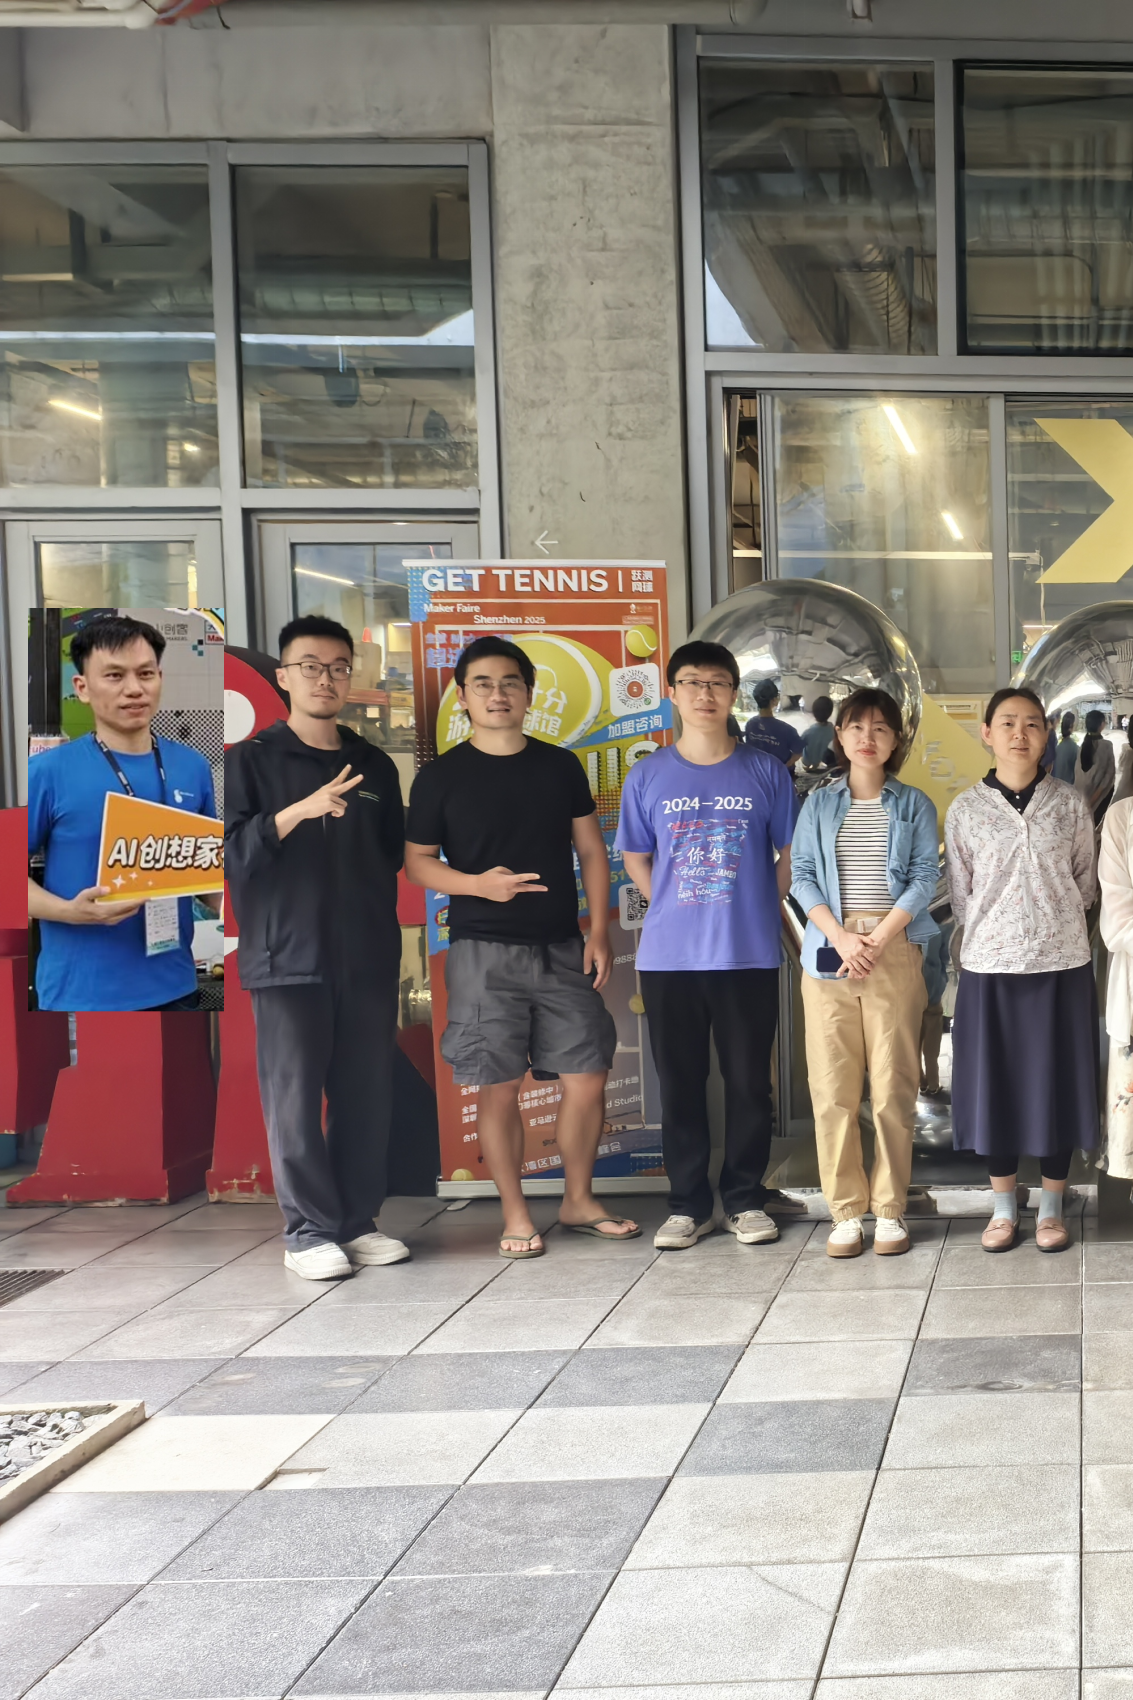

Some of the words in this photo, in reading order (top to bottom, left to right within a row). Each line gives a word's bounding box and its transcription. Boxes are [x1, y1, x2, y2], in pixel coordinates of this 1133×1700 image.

[421, 569, 486, 592] GET
[492, 569, 608, 592] TENNIS
[424, 604, 454, 614] Maker
[456, 603, 480, 613] Faire
[473, 614, 522, 624] Shenzhen
[524, 615, 546, 624] 2025
[607, 714, 663, 739] 加盟咨询
[107, 835, 224, 869] AI创想家
[614, 1095, 644, 1107] Studio
